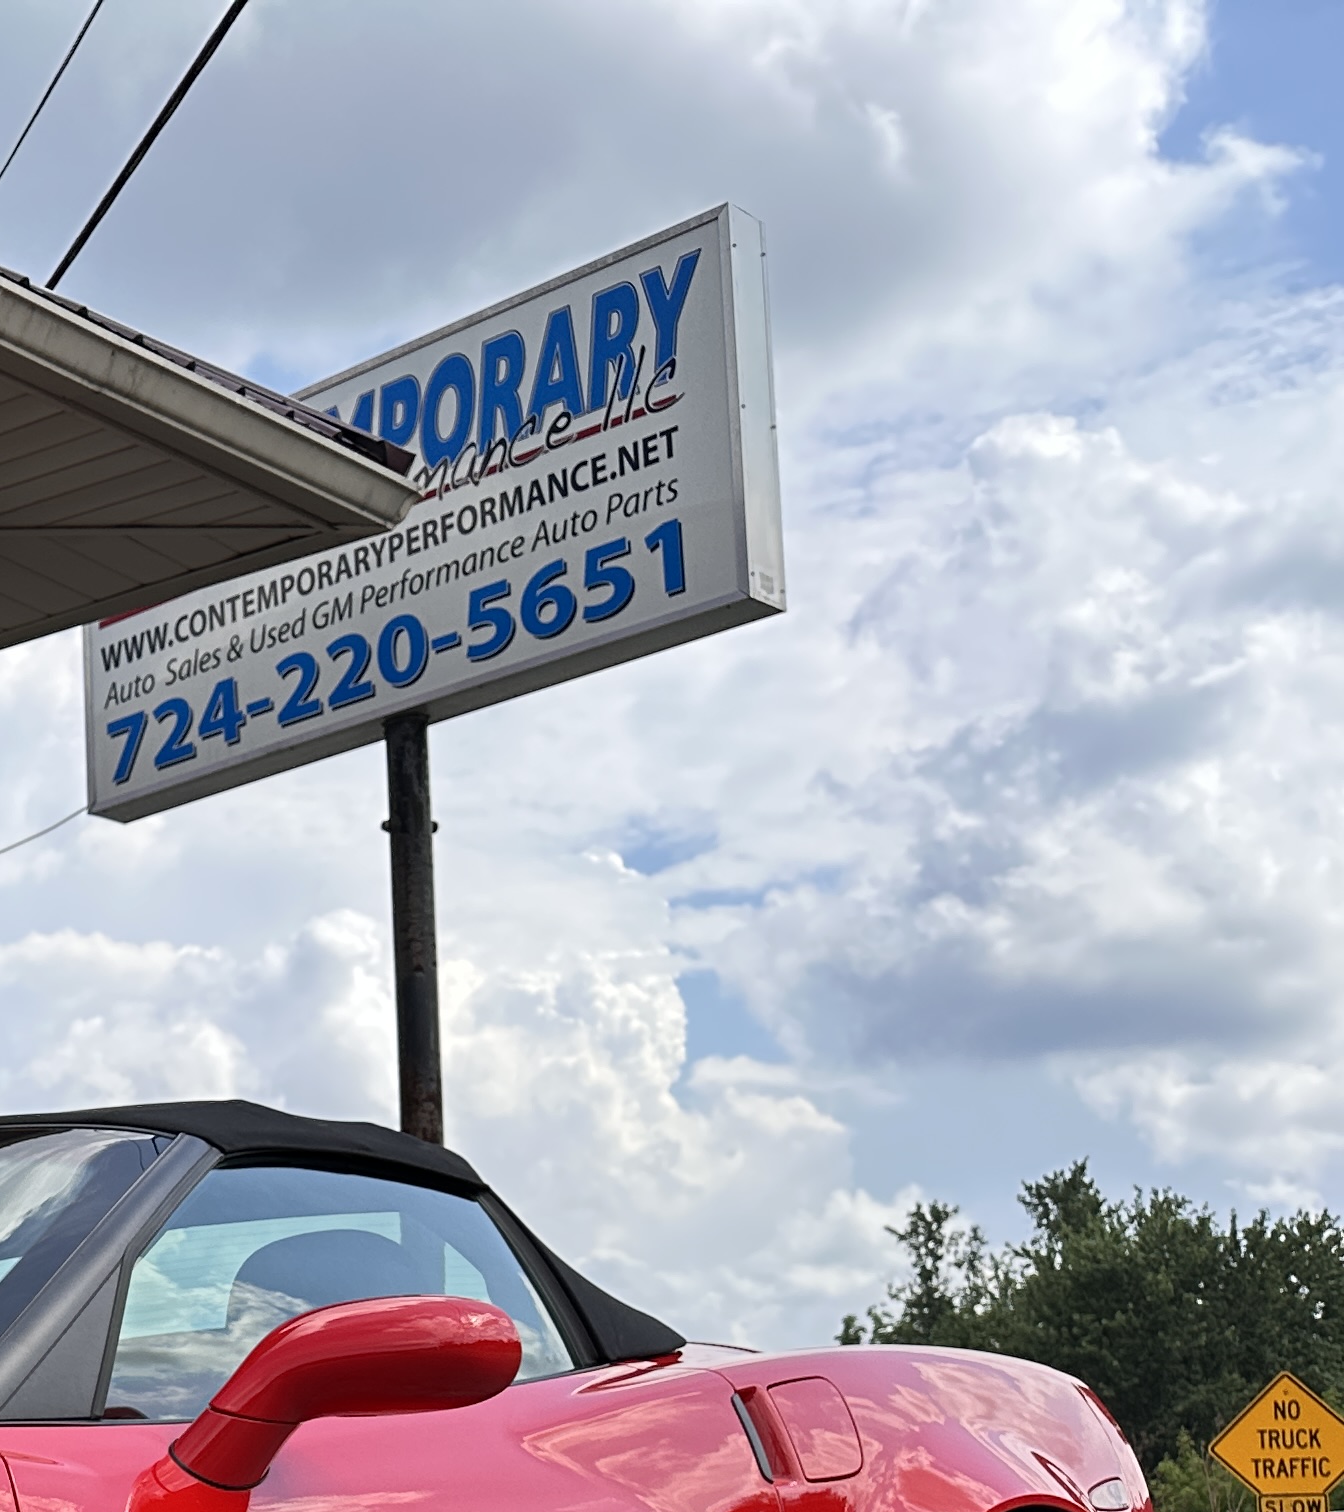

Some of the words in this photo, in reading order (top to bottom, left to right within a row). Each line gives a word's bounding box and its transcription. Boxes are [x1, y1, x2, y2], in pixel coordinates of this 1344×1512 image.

[100, 425, 679, 672] WWW.CONTEMPORARYPERFORMANCE.NET
[104, 673, 155, 710] Auto
[165, 649, 221, 686] Sales
[226, 634, 244, 663] &
[250, 607, 307, 654] Used
[312, 592, 353, 631] GM
[360, 535, 524, 614] Performance
[531, 510, 598, 552] Auto
[606, 478, 679, 525] Parts
[106, 518, 687, 785] 724-220-5651
[1251, 1457, 1331, 1479] TRAFFIC
[1256, 1428, 1321, 1449] TRUCK
[1274, 1400, 1300, 1420] NO
